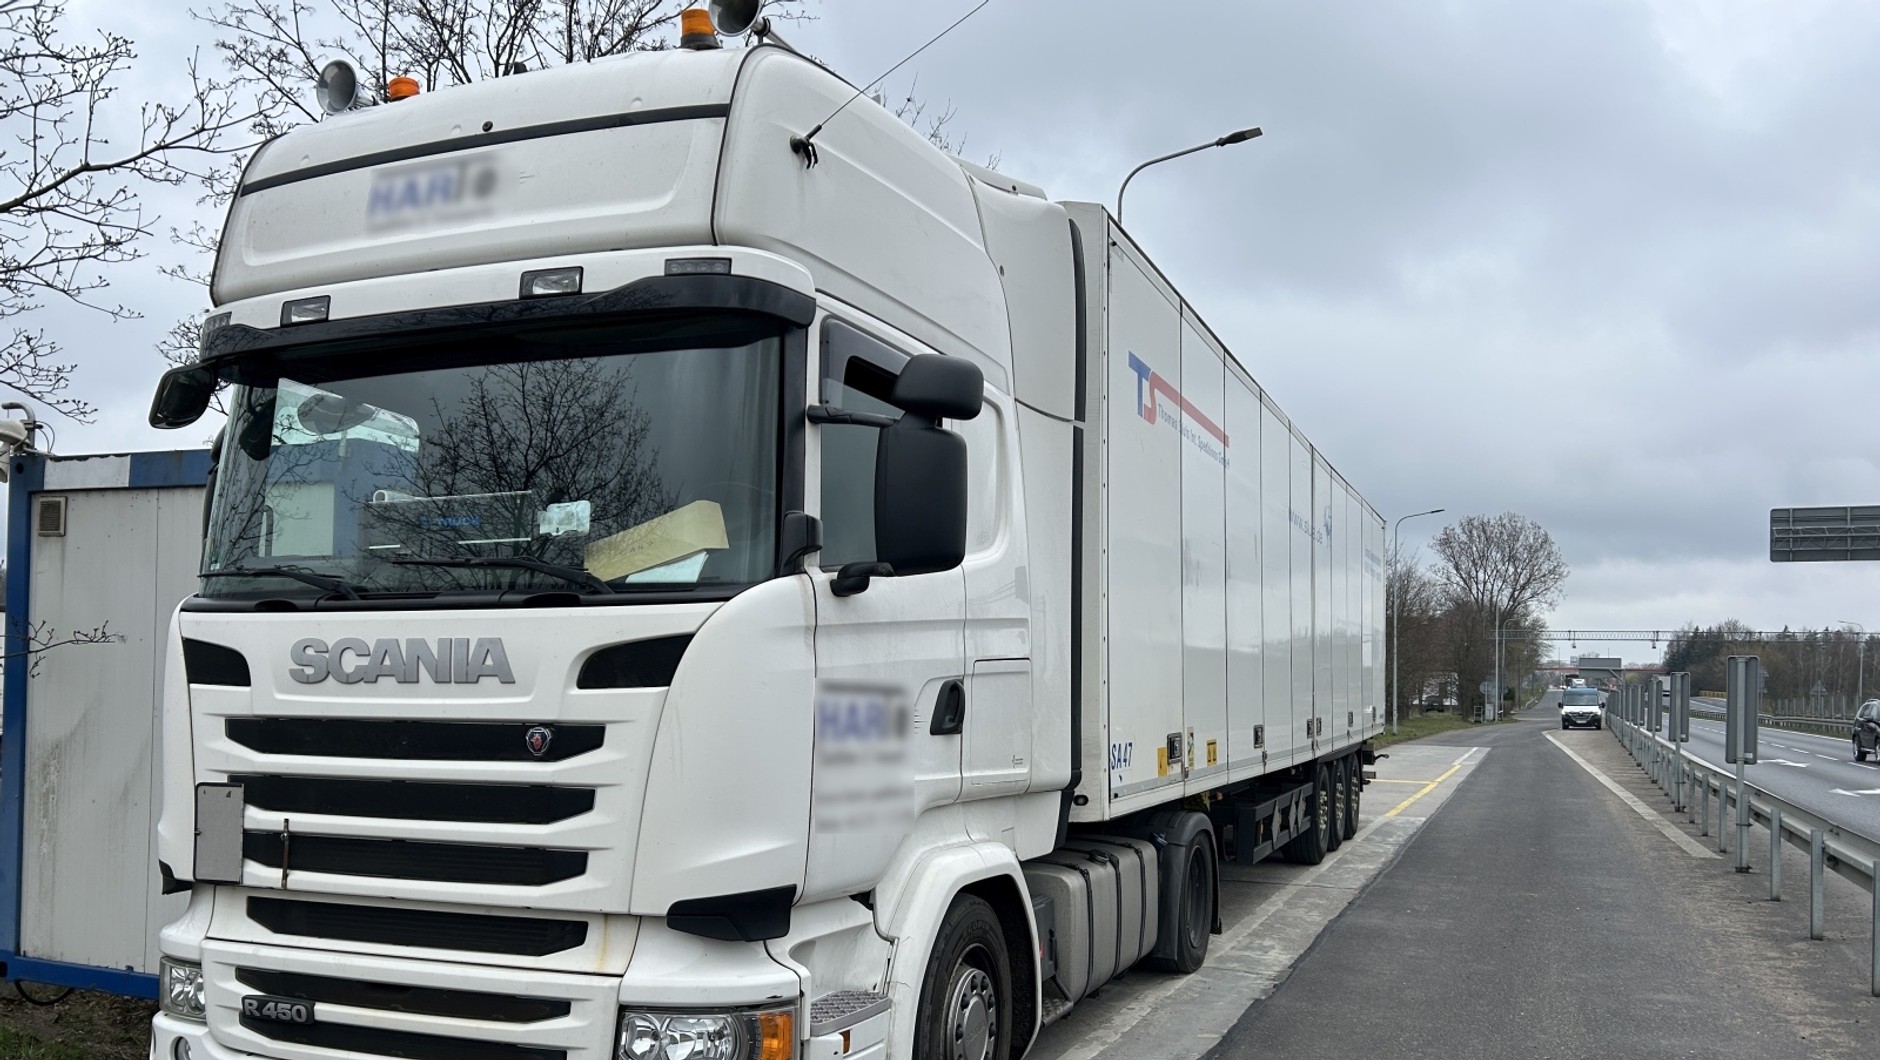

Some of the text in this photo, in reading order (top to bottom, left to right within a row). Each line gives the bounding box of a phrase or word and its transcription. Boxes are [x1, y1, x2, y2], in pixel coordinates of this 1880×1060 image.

[289, 637, 516, 685] SCANIA
[244, 999, 307, 1023] R 450
